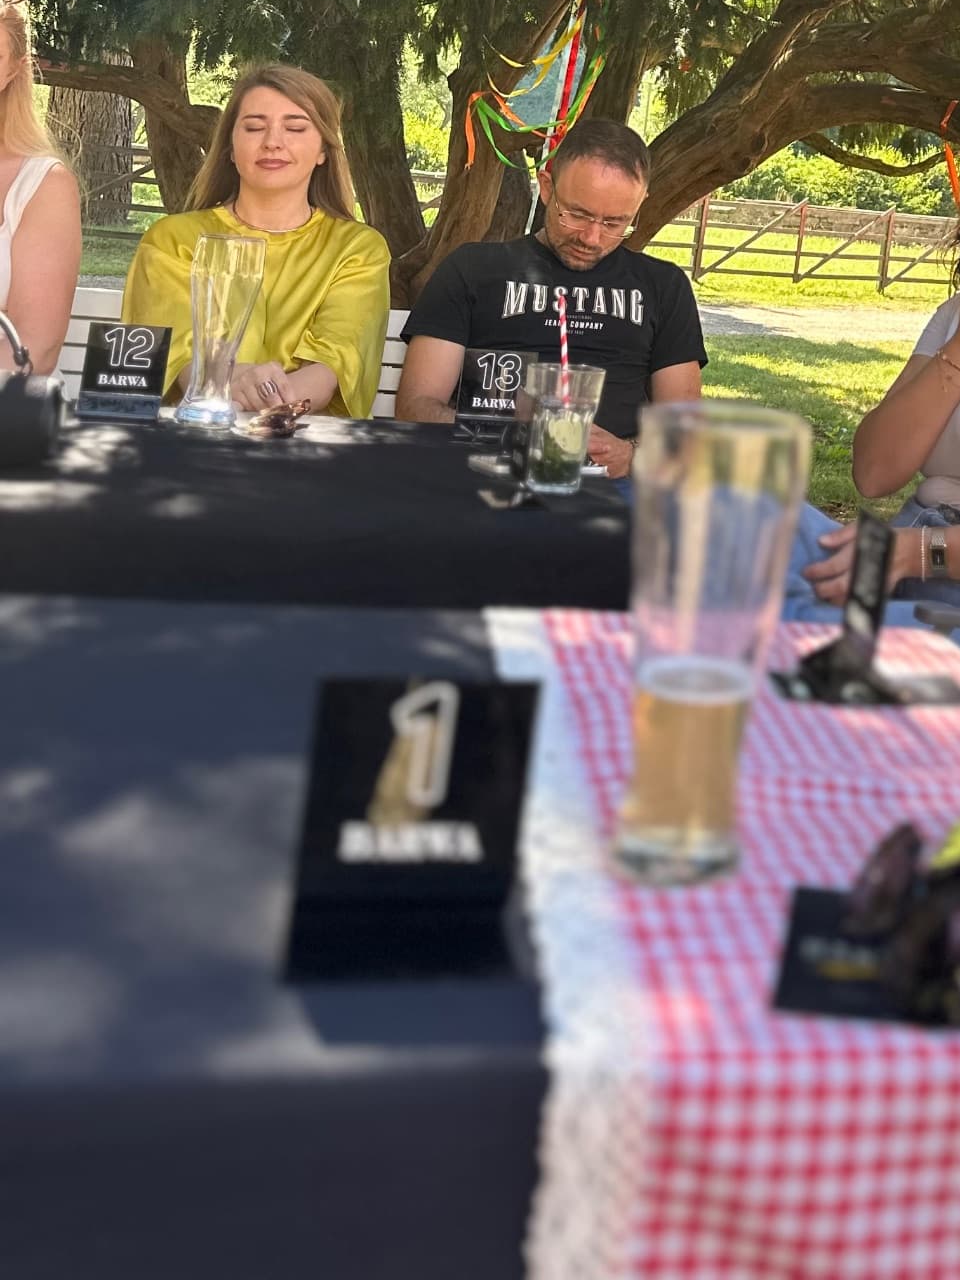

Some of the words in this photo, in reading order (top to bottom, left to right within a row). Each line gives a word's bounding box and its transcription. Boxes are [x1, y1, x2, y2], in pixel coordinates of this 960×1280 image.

[502, 280, 644, 326] MUSTANG
[570, 320, 603, 330] COMPANY
[105, 327, 154, 368] 12
[98, 373, 147, 387] BARWA
[477, 352, 522, 392] 13
[472, 397, 516, 409] BARWA
[391, 681, 460, 805] 1
